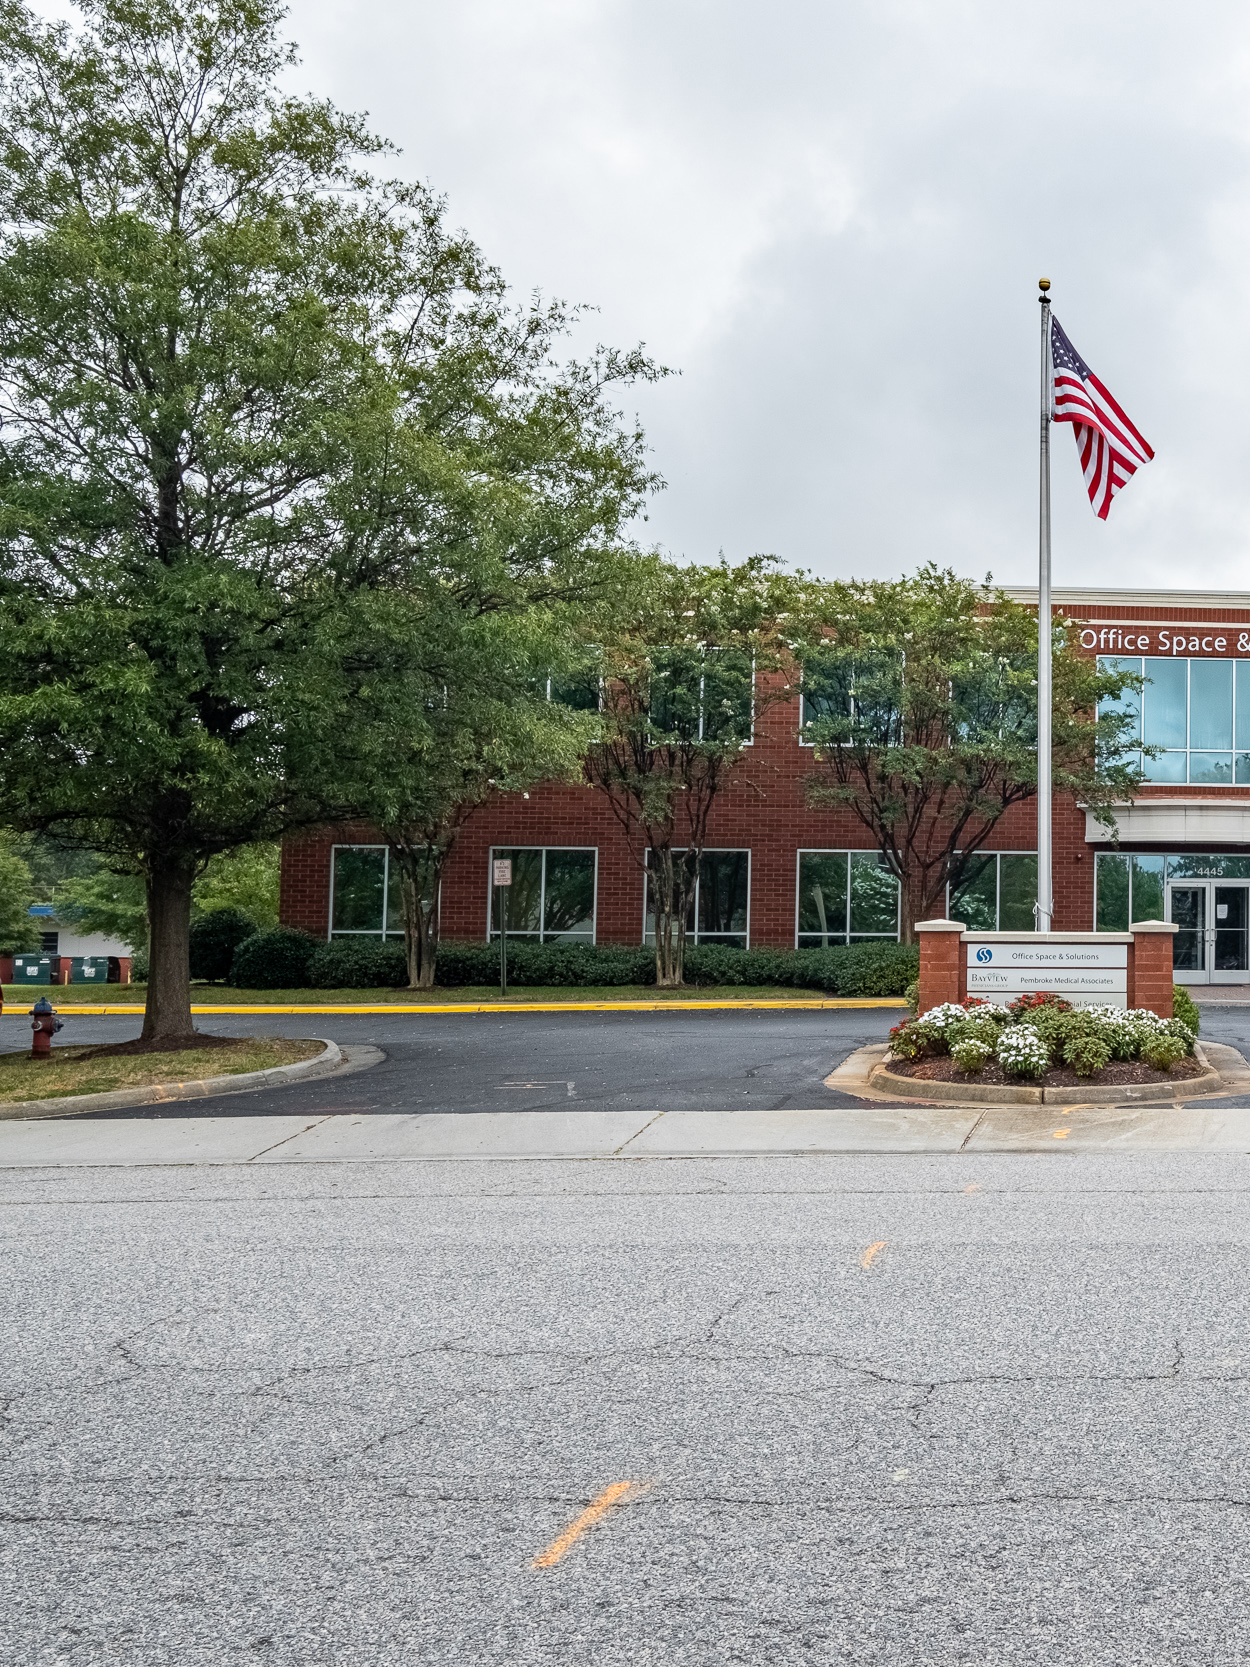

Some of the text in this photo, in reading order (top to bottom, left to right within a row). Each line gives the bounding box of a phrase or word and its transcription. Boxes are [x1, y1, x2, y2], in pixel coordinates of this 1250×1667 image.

[1080, 629, 1150, 650] Office
[1158, 631, 1227, 655] Space
[1197, 867, 1224, 876] 4445
[1012, 952, 1034, 960] Office
[1035, 952, 1057, 961] Space
[1080, 977, 1114, 985] Associates
